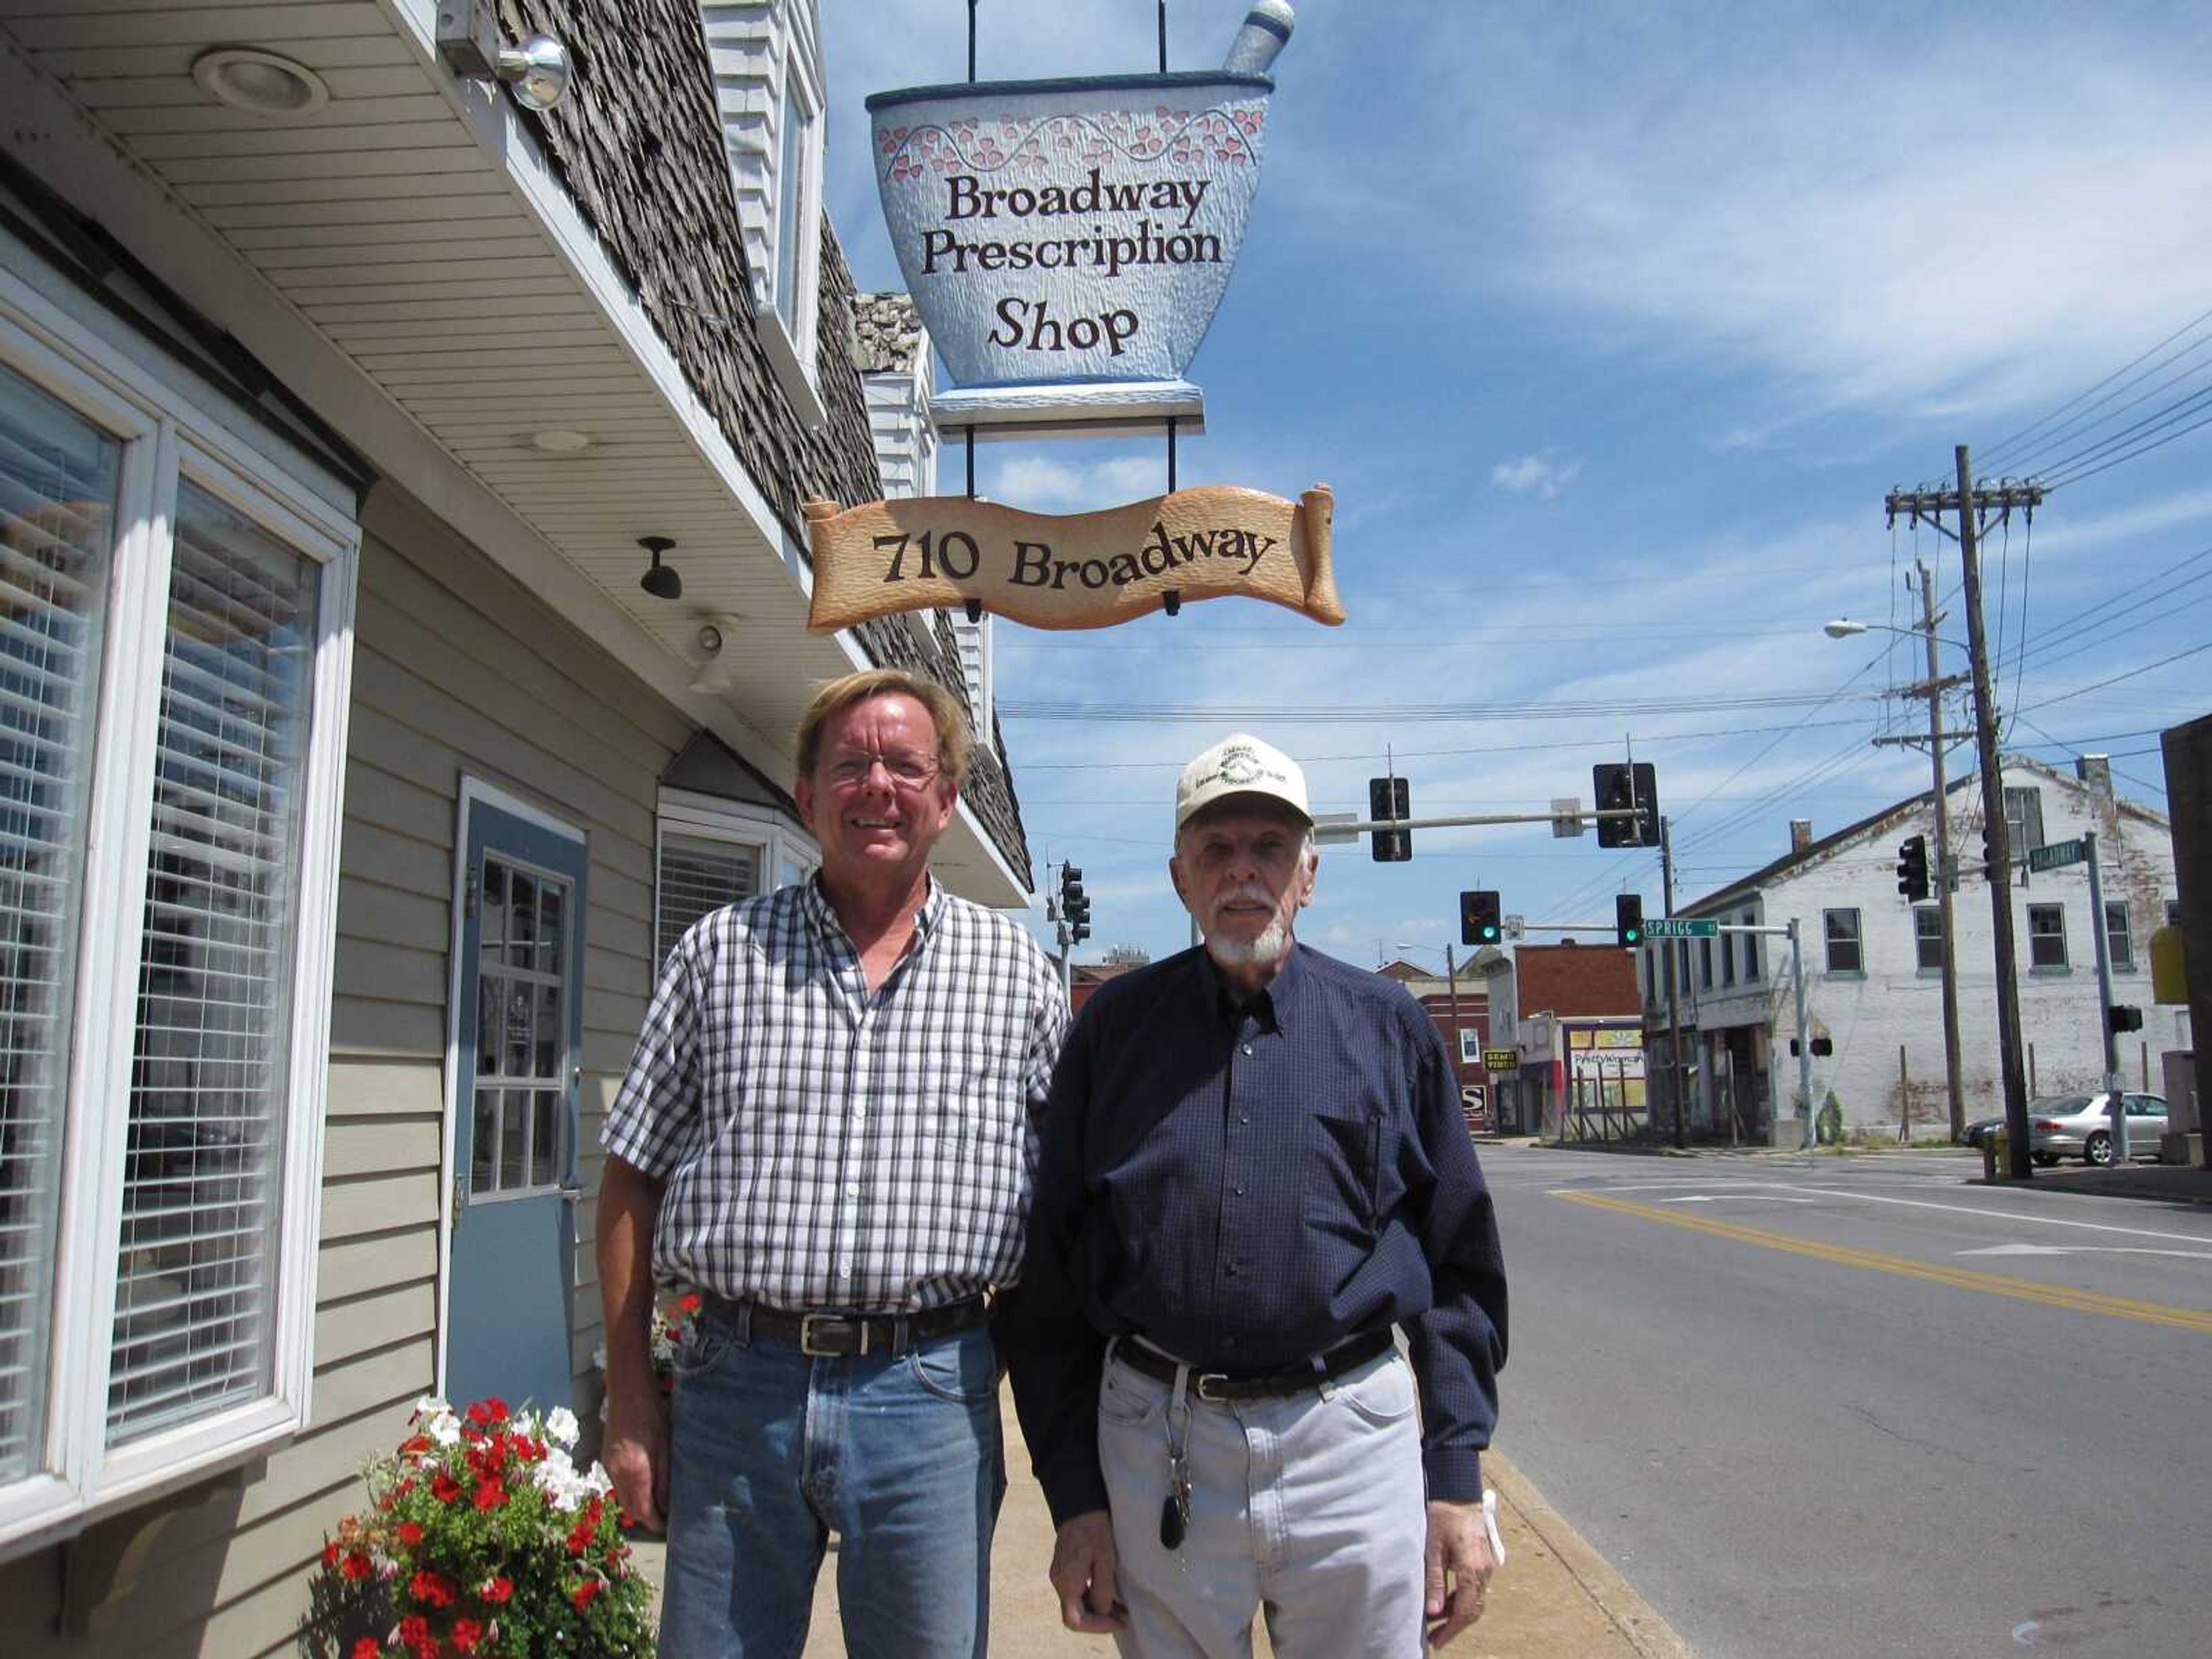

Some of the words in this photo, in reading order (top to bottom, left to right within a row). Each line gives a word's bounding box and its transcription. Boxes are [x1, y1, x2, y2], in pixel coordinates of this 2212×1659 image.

[944, 171, 1213, 228] Broadway
[922, 221, 1222, 277] Prescription
[988, 297, 1139, 356] Shop
[873, 531, 980, 582] 710
[1008, 521, 1277, 589] Broadway
